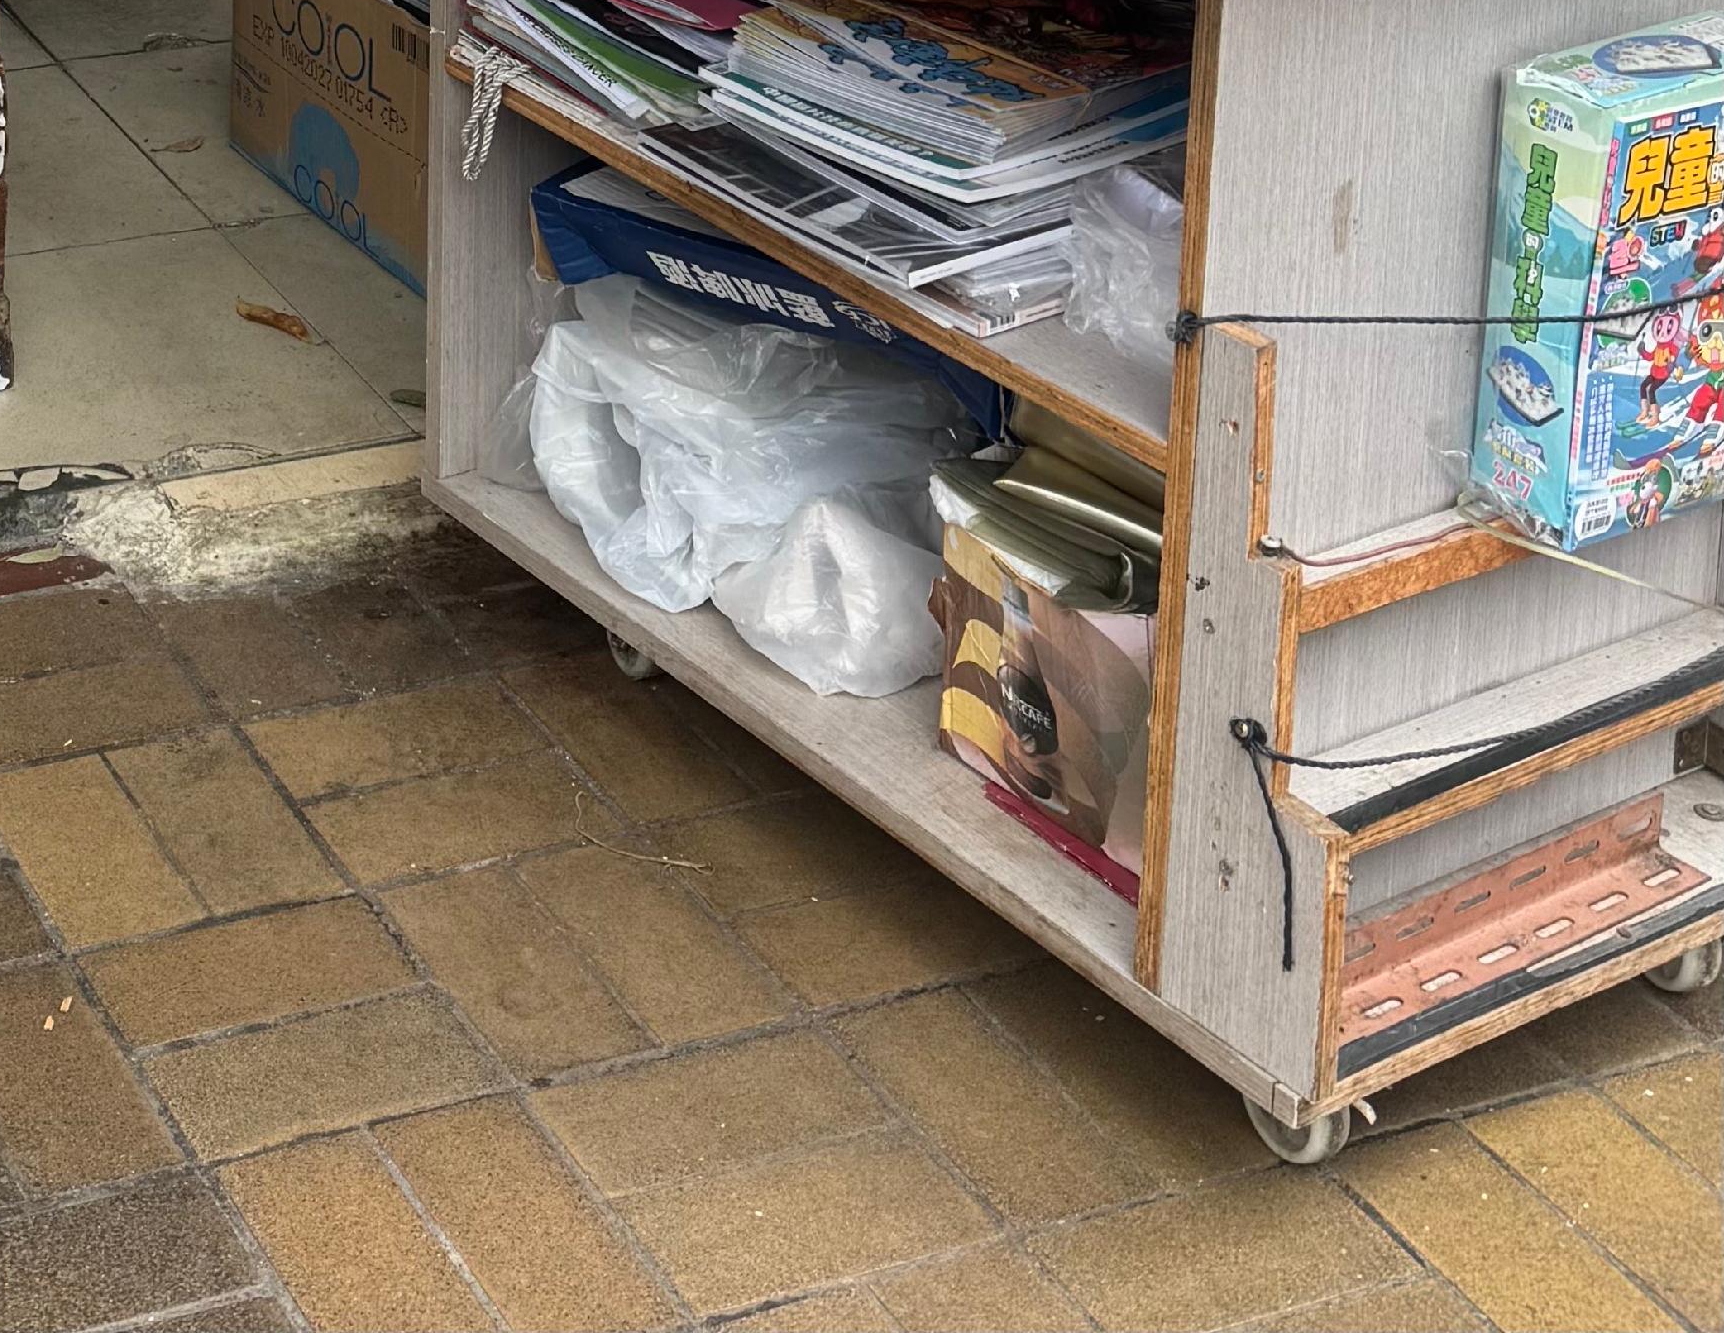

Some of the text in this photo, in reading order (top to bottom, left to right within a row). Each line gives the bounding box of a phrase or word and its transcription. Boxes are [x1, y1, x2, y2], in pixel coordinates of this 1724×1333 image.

[252, 14, 275, 40] EXP
[1510, 143, 1559, 344] 兒童的科學
[1649, 219, 1688, 246] STEM
[1491, 460, 1533, 502] 247
